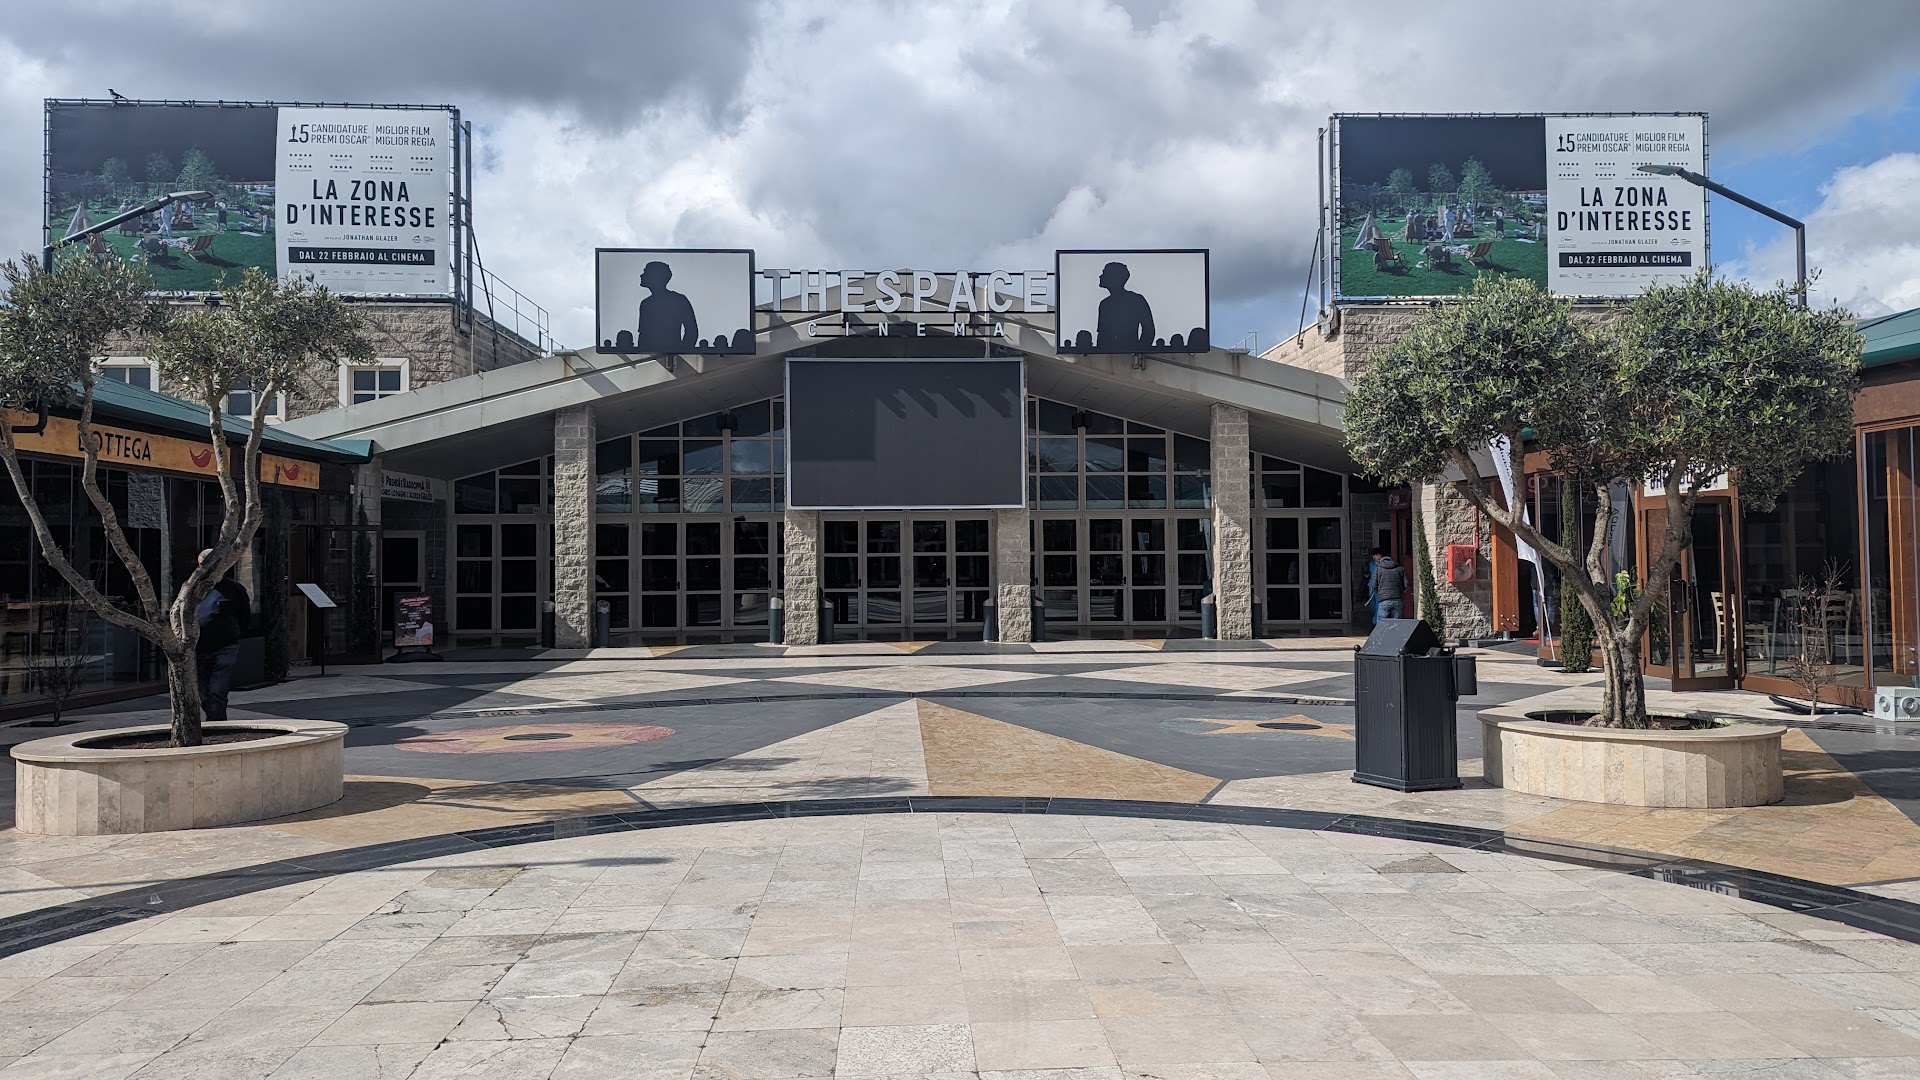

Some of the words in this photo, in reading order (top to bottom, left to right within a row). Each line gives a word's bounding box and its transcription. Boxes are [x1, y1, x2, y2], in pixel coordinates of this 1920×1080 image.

[311, 124, 368, 134] CANDIDATURE
[375, 126, 408, 135] MIGLIOR
[411, 127, 430, 136] FILM
[311, 135, 337, 144] PREMI
[375, 136, 408, 146] MIGLIOR
[411, 137, 436, 147] REGIA
[1576, 133, 1629, 142] CANDIDATURE
[1635, 133, 1666, 141] MIGLIOR
[1667, 133, 1685, 141] FILM
[1577, 143, 1601, 152] PREMI
[1635, 143, 1666, 152] MIGLIOR
[1667, 143, 1690, 152] REGIA
[313, 179, 338, 200] LA
[350, 180, 410, 202] ZONA
[1581, 187, 1603, 207] LA
[1615, 187, 1668, 207] ZONA
[299, 251, 316, 260] DAL
[318, 251, 329, 260] 22
[332, 252, 375, 261] FEBBRAIO
[377, 252, 389, 261] AL
[391, 252, 425, 262] CINEMA
[1568, 255, 1583, 264] DAL
[1586, 255, 1596, 264] 22
[1598, 255, 1637, 264] FEBBRAIO
[1639, 255, 1650, 264] AL
[1652, 255, 1683, 264] CINEMA
[808, 322, 1005, 337] CINEMA
